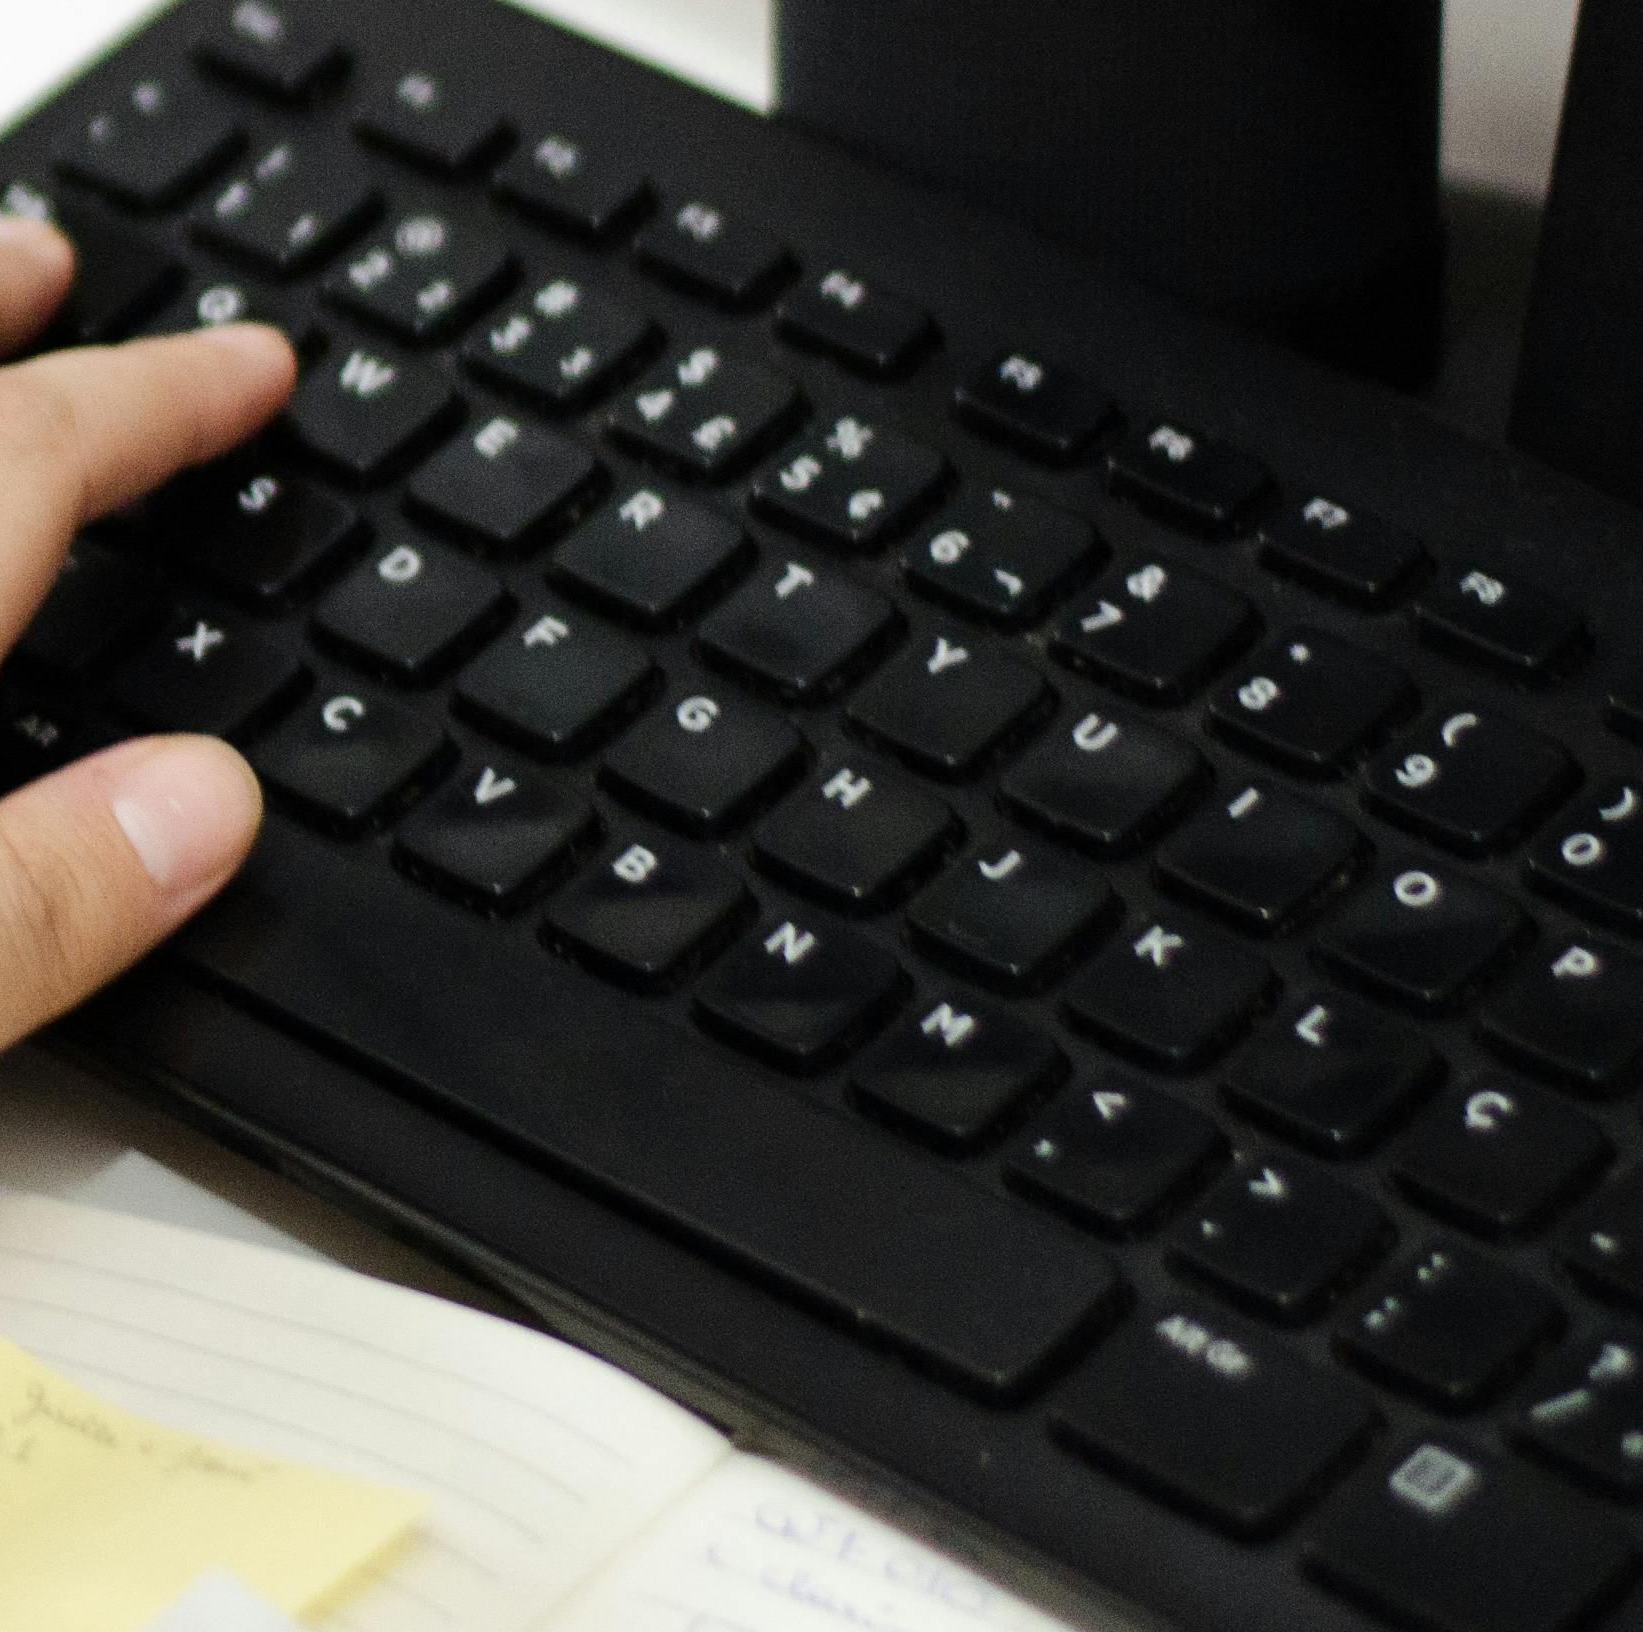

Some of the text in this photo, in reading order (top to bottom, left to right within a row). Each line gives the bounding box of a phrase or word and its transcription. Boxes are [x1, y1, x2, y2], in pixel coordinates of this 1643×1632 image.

[339, 350, 396, 396] W
[635, 388, 675, 422] 4
[778, 454, 822, 492] 5
[237, 476, 278, 513] S
[618, 489, 666, 531] R
[377, 544, 423, 584] D
[928, 528, 971, 566] 6
[773, 561, 816, 599] T
[521, 614, 571, 648] F
[1080, 599, 1125, 633] 7
[176, 620, 225, 662] X
[926, 636, 970, 675] Y
[1236, 675, 1281, 712] 8
[321, 694, 366, 733] C
[675, 695, 721, 734] G
[1071, 712, 1120, 753] U
[1439, 711, 1479, 749] (
[472, 765, 517, 805] V
[821, 767, 872, 810] H
[1394, 752, 1438, 789] 9
[1226, 786, 1261, 820] I
[1599, 785, 1638, 822] )
[611, 843, 659, 884] B
[976, 848, 1023, 882] J
[1391, 869, 1441, 909] O
[763, 920, 817, 965] N
[1132, 924, 1184, 968] K
[1550, 944, 1600, 978] P
[919, 1001, 976, 1047] M
[1293, 1003, 1328, 1047] L
[1090, 1089, 1127, 1121] <
[1249, 1166, 1286, 1199] >
[1528, 1387, 1591, 1423] /
